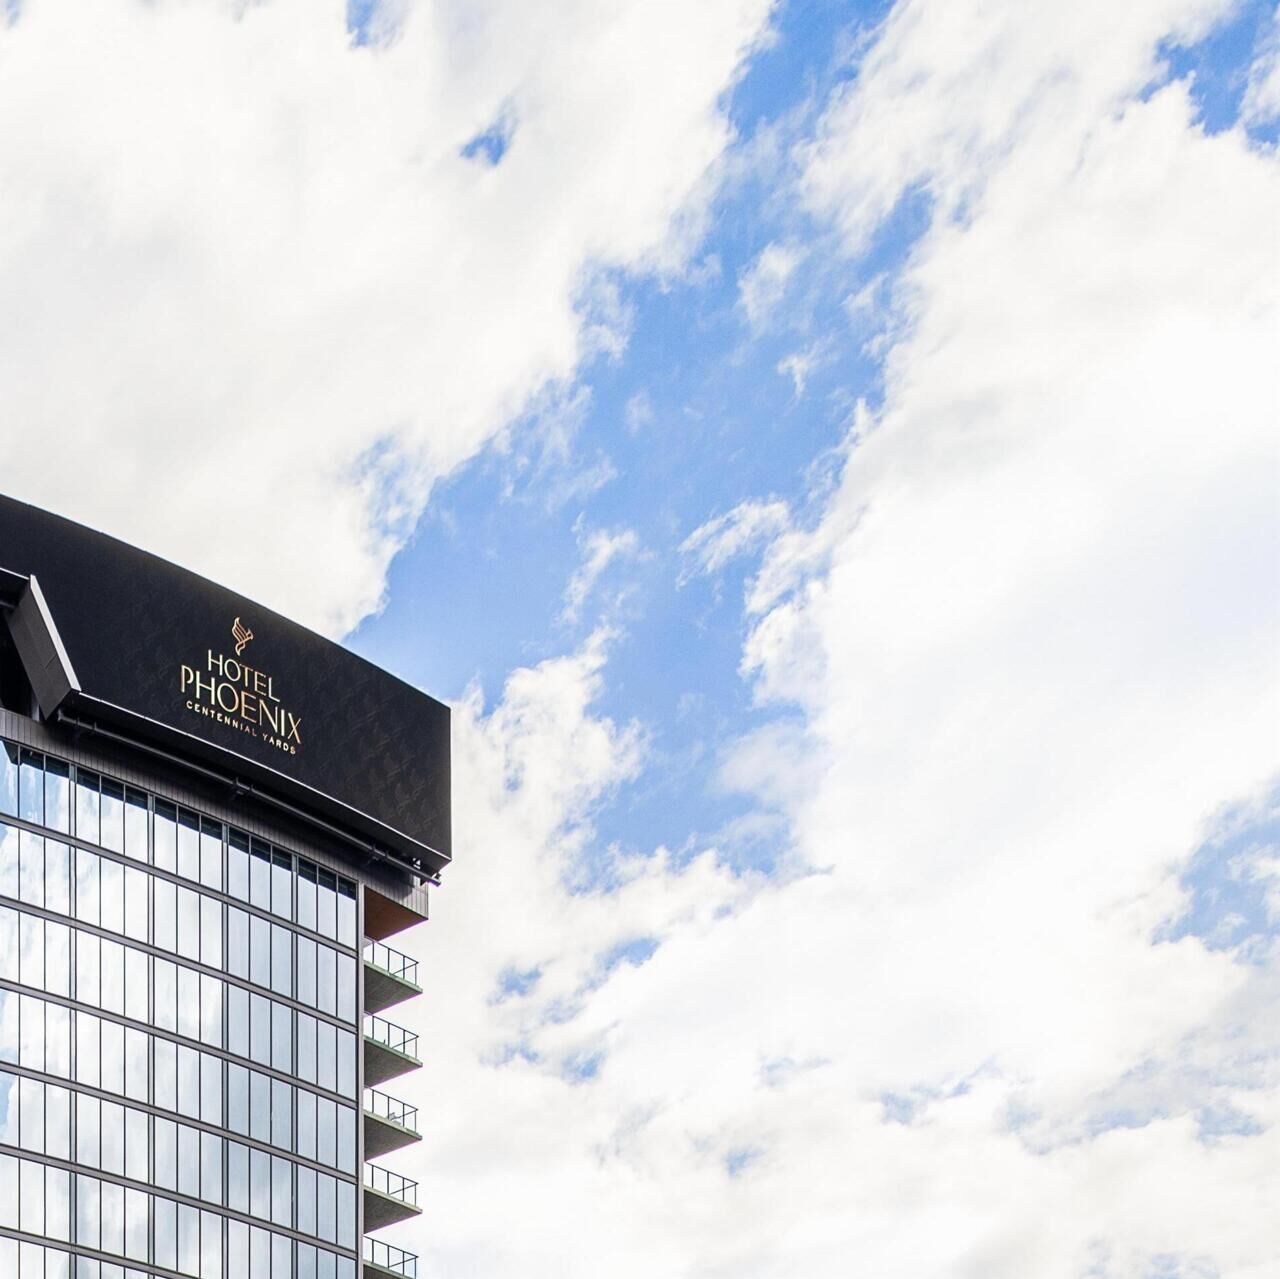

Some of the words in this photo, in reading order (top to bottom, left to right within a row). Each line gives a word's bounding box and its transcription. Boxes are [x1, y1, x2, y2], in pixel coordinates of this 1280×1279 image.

[207, 649, 281, 703] HOTEL
[181, 664, 302, 745] PHOENIX
[186, 700, 258, 737] CENTENNIAL
[262, 732, 296, 755] YARDS
